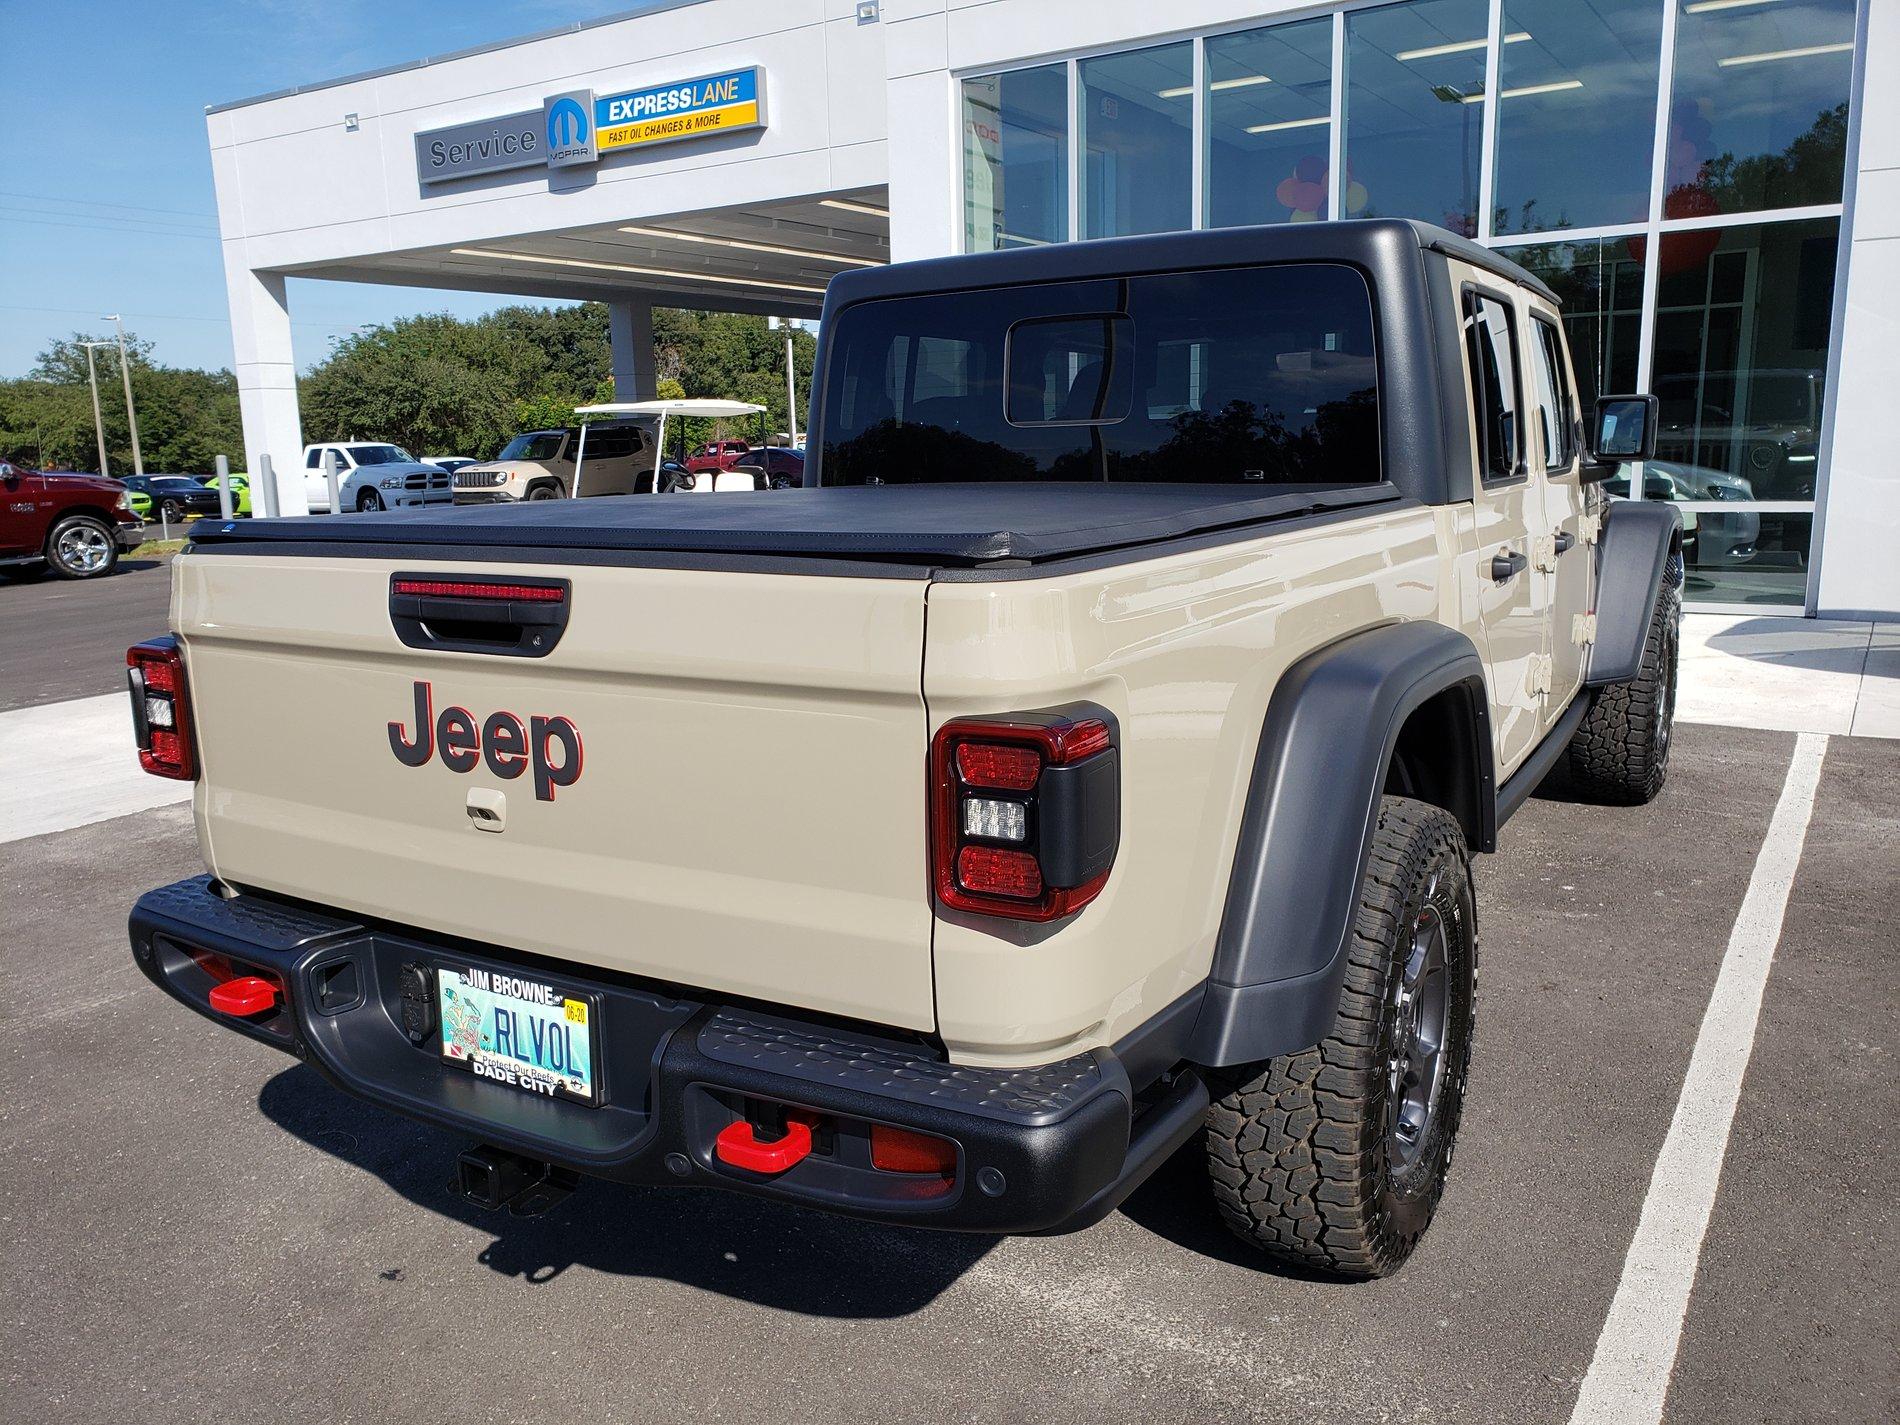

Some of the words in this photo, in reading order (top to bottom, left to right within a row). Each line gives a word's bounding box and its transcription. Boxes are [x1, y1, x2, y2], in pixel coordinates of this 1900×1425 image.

[609, 131, 628, 143] FAST
[630, 128, 642, 140] OIL
[645, 120, 683, 137] CHANGES
[686, 119, 692, 130] &
[695, 114, 721, 128] MORE
[430, 129, 536, 168] Service
[388, 681, 584, 801] Jeep
[467, 968, 490, 991] JIM
[493, 974, 553, 1005] BROWNE
[494, 1006, 584, 1078] RLVOL
[473, 1062, 517, 1085] DADE
[520, 1075, 557, 1096] CITY
[482, 1055, 512, 1071] Protect
[514, 1064, 530, 1076] Our
